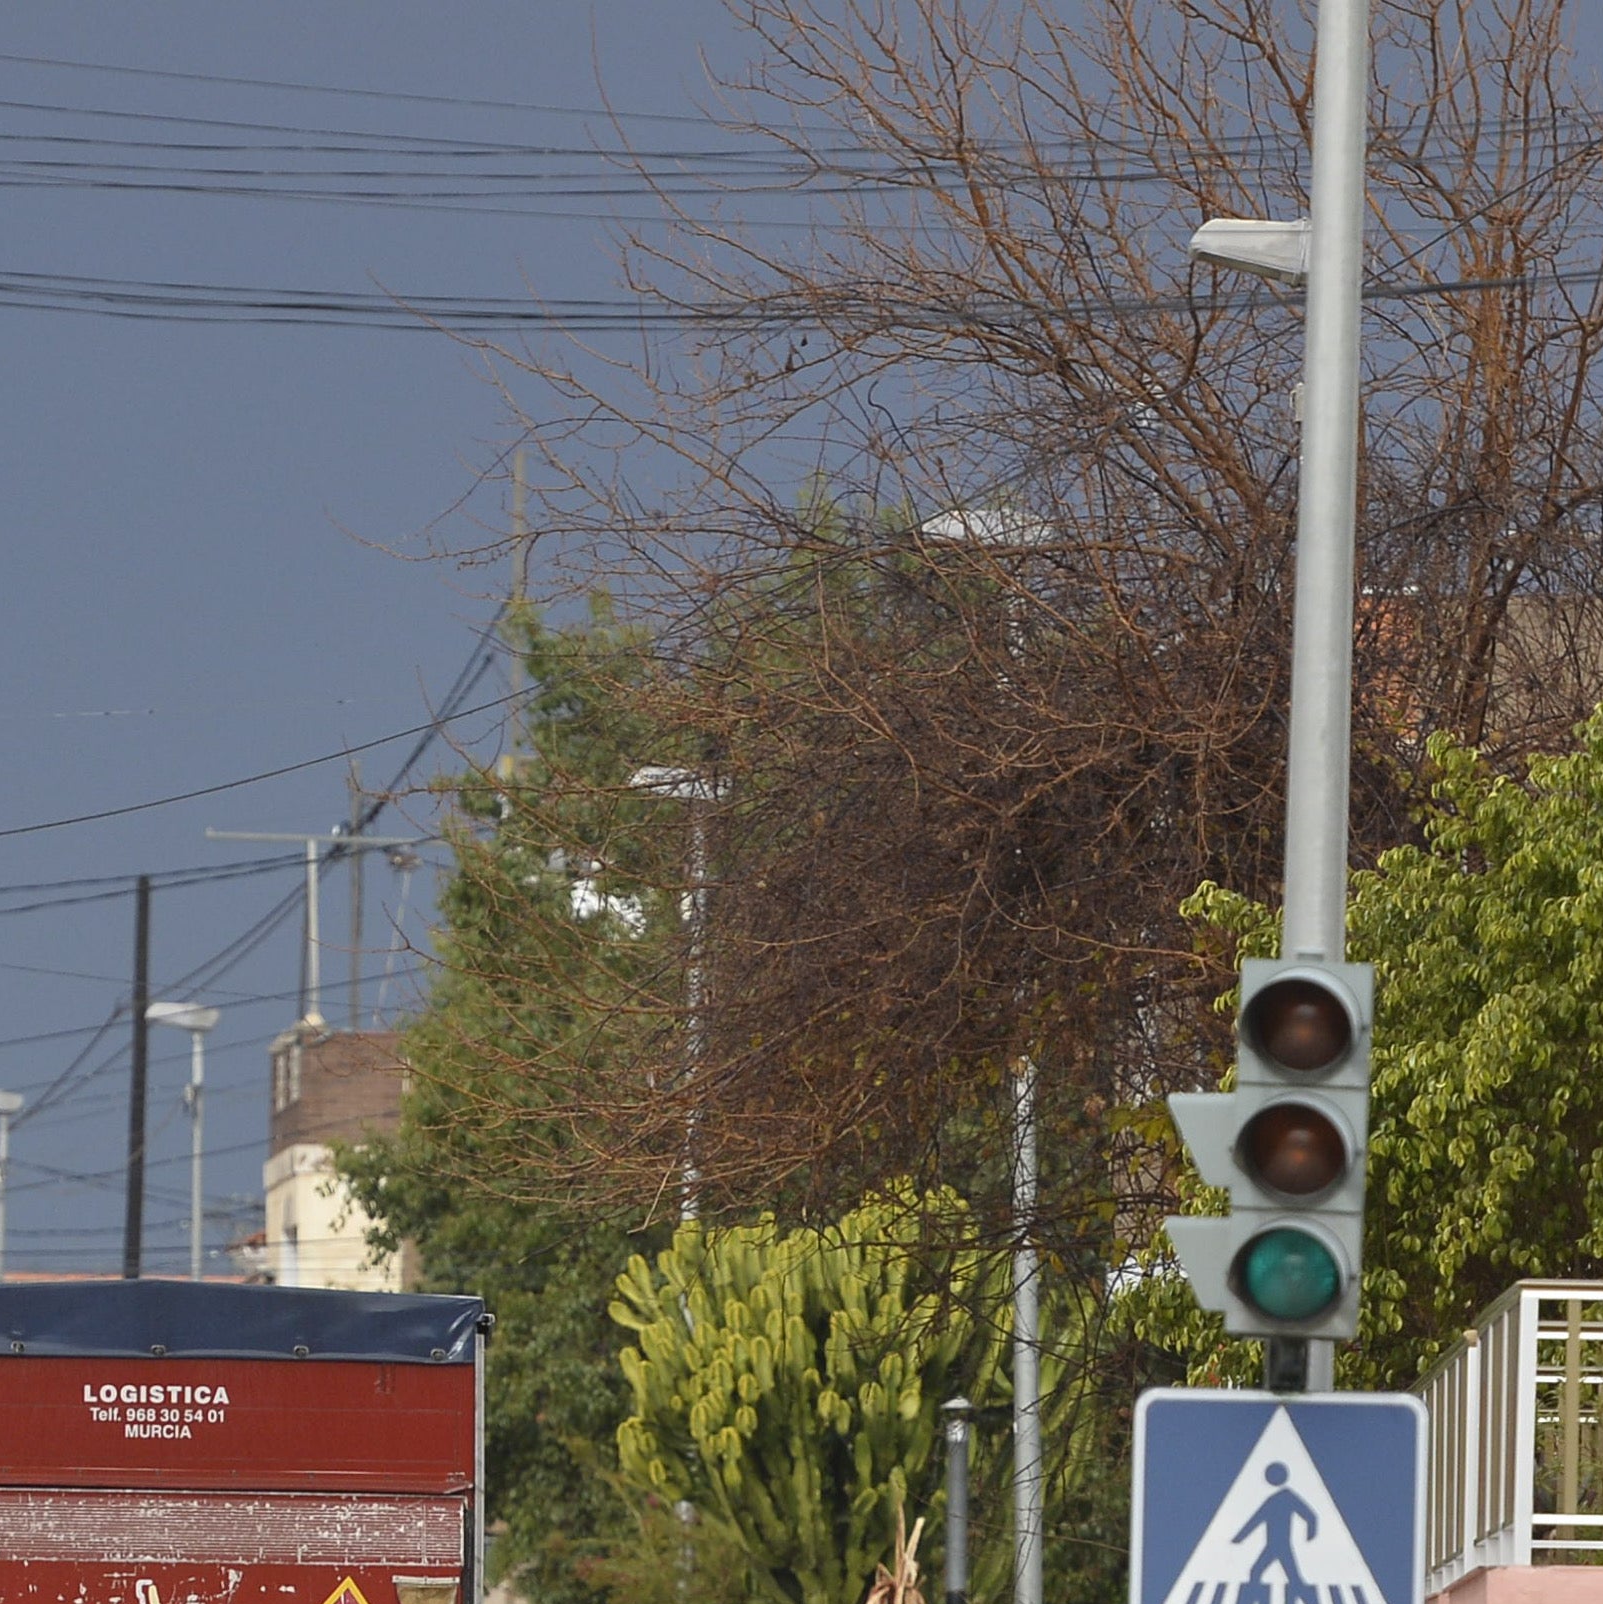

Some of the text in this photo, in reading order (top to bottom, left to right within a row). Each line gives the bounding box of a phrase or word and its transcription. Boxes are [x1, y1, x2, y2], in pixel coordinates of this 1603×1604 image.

[83, 1384, 230, 1405] LOGISTICA
[90, 1407, 225, 1423] Telf. 968 30 54 01
[124, 1424, 192, 1439] MURCIA
